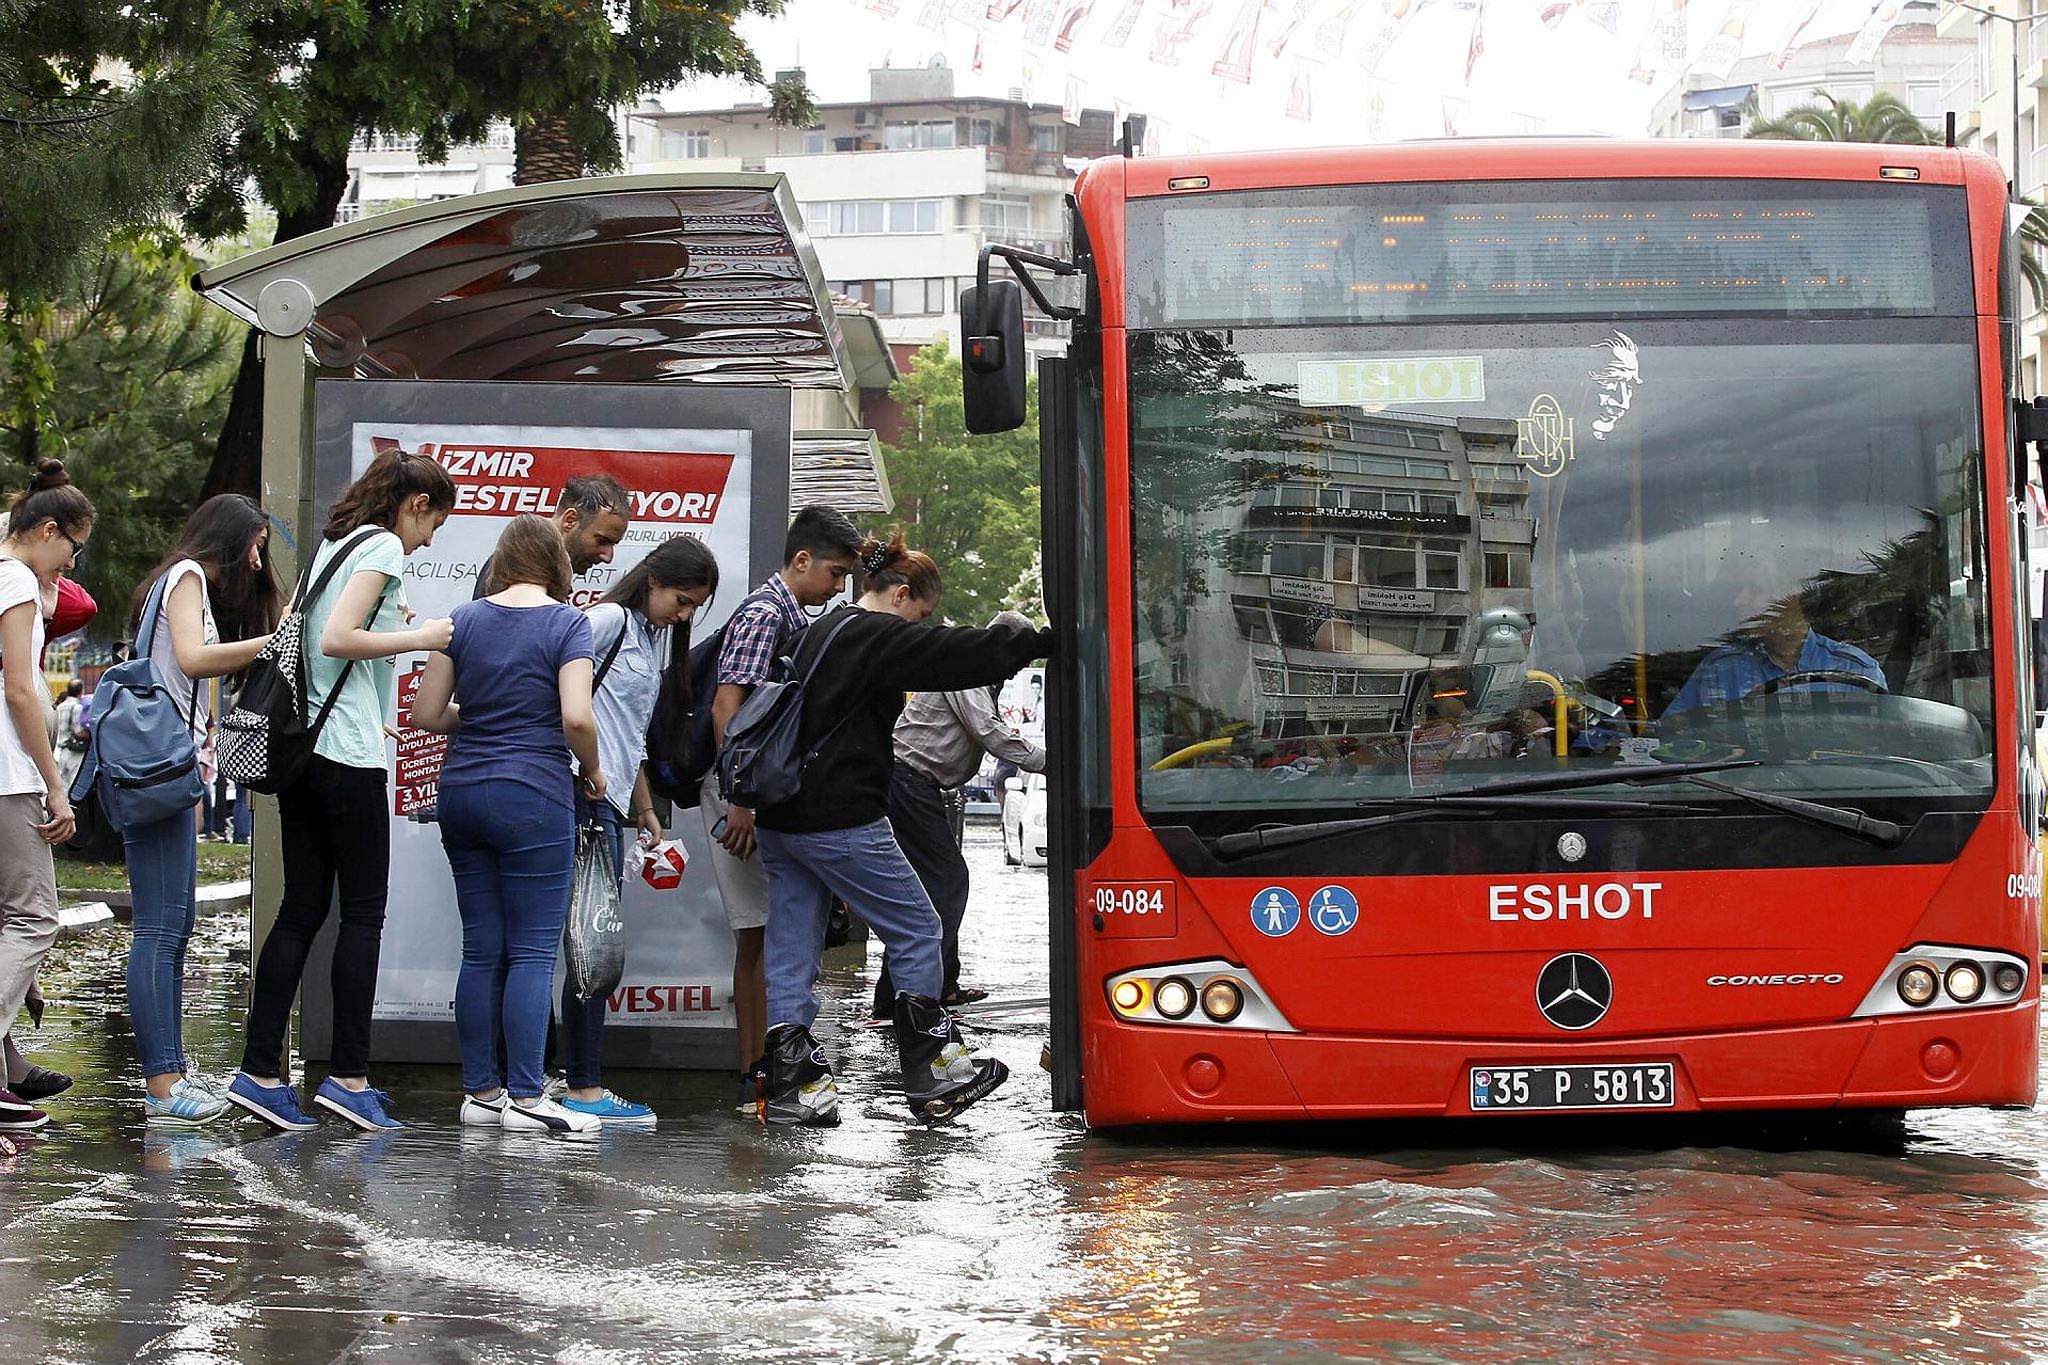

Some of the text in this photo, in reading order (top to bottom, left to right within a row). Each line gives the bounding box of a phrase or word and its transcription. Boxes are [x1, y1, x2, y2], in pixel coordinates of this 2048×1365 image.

[1336, 362, 1478, 400] ESHOT
[441, 450, 534, 478] İZMİR
[398, 739, 424, 752] UYDU
[404, 764, 441, 780] MONTAJ
[402, 782, 439, 803] 3 YIL
[402, 796, 438, 812] GARANT
[1096, 887, 1164, 914] 09-084
[1489, 883, 1662, 921] ESHOT
[1706, 974, 1845, 986] CONECTO
[607, 986, 721, 1013] VESTEL
[1493, 1068, 1666, 1104] 35 P 5813
[1475, 1095, 1488, 1104] TR
